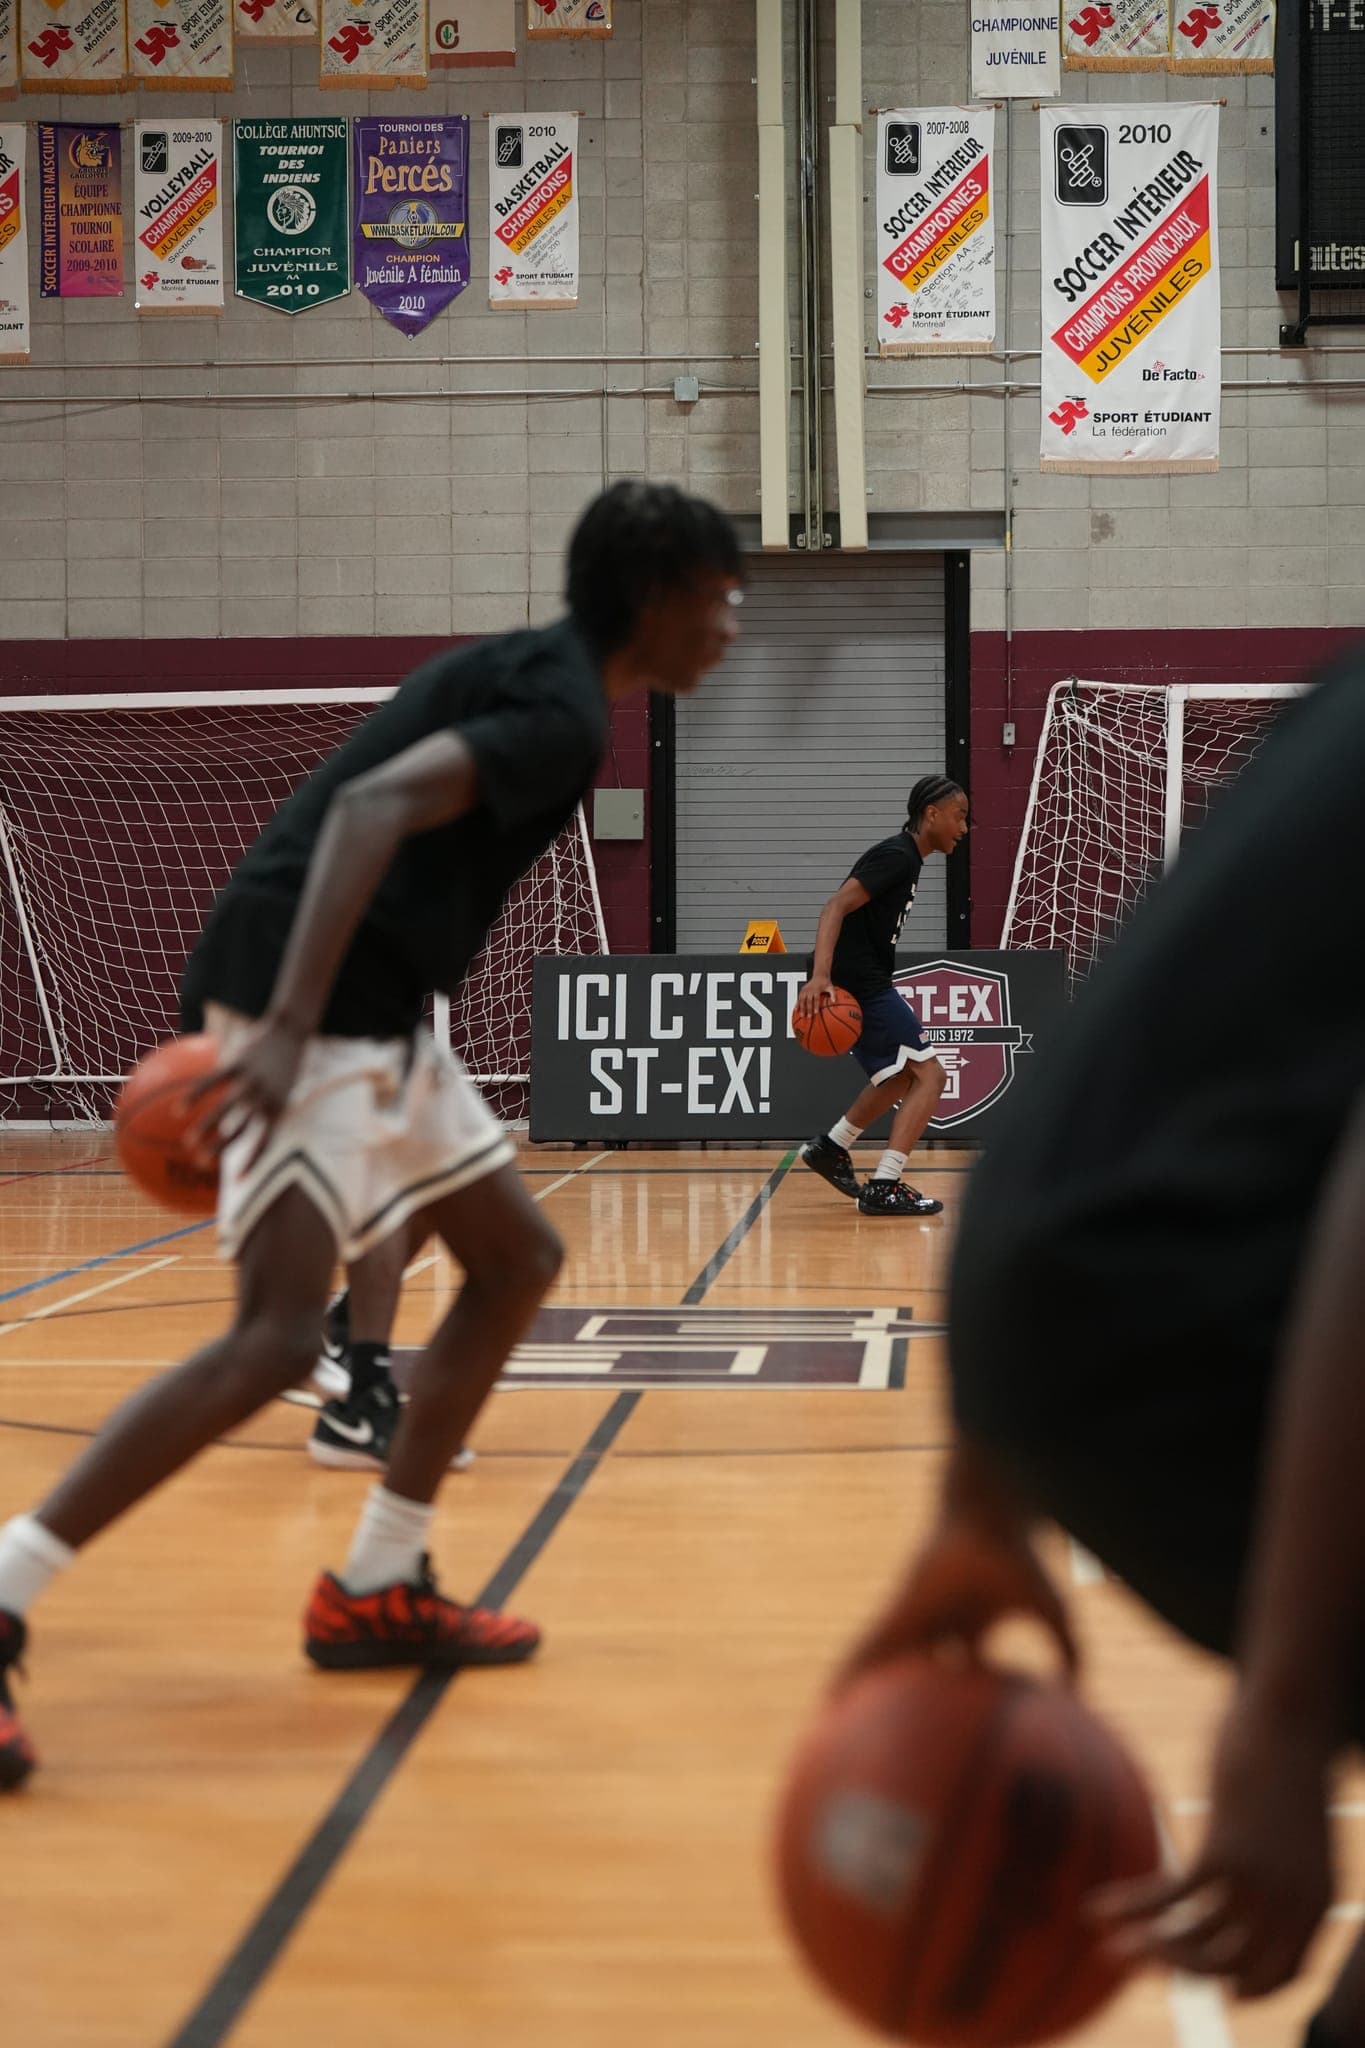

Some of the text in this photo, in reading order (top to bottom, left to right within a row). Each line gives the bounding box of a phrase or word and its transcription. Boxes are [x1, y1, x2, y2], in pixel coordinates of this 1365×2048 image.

[75, 14, 96, 36] SPORT
[181, 12, 202, 34] SPORT
[374, 10, 397, 32] SPORT
[972, 17, 1058, 32] CHAMPIONNE
[1120, 23, 1130, 33] de
[83, 16, 119, 53] Montréal
[190, 15, 225, 51] Montréal
[383, 12, 419, 48] Montréal
[1226, 25, 1236, 35] de
[986, 48, 1046, 65] JUVÉNILE
[236, 122, 346, 139] COLLÈGE AHUNTSIC
[378, 123, 444, 133] TOURNOI DES
[528, 126, 556, 137] 2010
[926, 120, 969, 135] 2007-2008
[1118, 124, 1172, 144] 2010
[172, 132, 212, 143] 2009-2010
[378, 136, 441, 156] Paniers
[259, 145, 324, 156] TOURNOI
[278, 159, 305, 170] DES
[140, 148, 214, 219] VOLLEYBALL
[262, 173, 321, 184] INDIENS
[364, 156, 453, 195] Percés
[494, 142, 569, 216] BASKETBALL
[74, 182, 108, 199] ÉQUIPE
[883, 192, 932, 239] SOCCER
[924, 137, 984, 198] INTÉRIEUR
[42, 126, 57, 291] SOCCER INTÉRIEUR MASCULIN
[501, 170, 568, 239] CHAMPIONS
[556, 193, 570, 207] AA
[61, 203, 122, 217] CHAMPIONNE
[145, 177, 212, 244] CHAMPIONNES
[70, 221, 113, 235] TOURNOI
[161, 199, 214, 255] JUVÉNILES
[371, 225, 457, 237] WWW.BASKETLAVAL.COM
[892, 178, 982, 272] CHAMPIONNES
[1053, 150, 1203, 303] SOCCER INTÉRIEUR
[69, 240, 115, 254] SCOLAIRE
[168, 226, 206, 264] Section A
[253, 247, 331, 257] CHAMPION
[912, 209, 984, 287] JUVÉNILES
[67, 259, 118, 272] 2009-2010
[247, 261, 339, 273] JUVÉNILE
[386, 254, 440, 263] CHAMPION
[364, 264, 461, 288] Juvénile A féminin
[921, 262, 956, 296] Section
[956, 247, 971, 263] AA
[1064, 210, 1201, 352] CHAMPIONS PROVINCIAUX
[266, 284, 320, 296] 2010
[398, 295, 426, 310] 2010
[912, 310, 991, 319] SPORT ÉTUDIANT
[1097, 258, 1203, 373] JUVÉNILES
[912, 320, 946, 328] Montréal
[1142, 368, 1159, 381] De
[1093, 410, 1212, 423] SPORT ÉTUDIANT
[1092, 426, 1167, 437] La fédération
[558, 972, 808, 1040] ICI C'EST
[948, 1029, 975, 1042] 1972
[590, 1046, 771, 1114] ST-EX!
